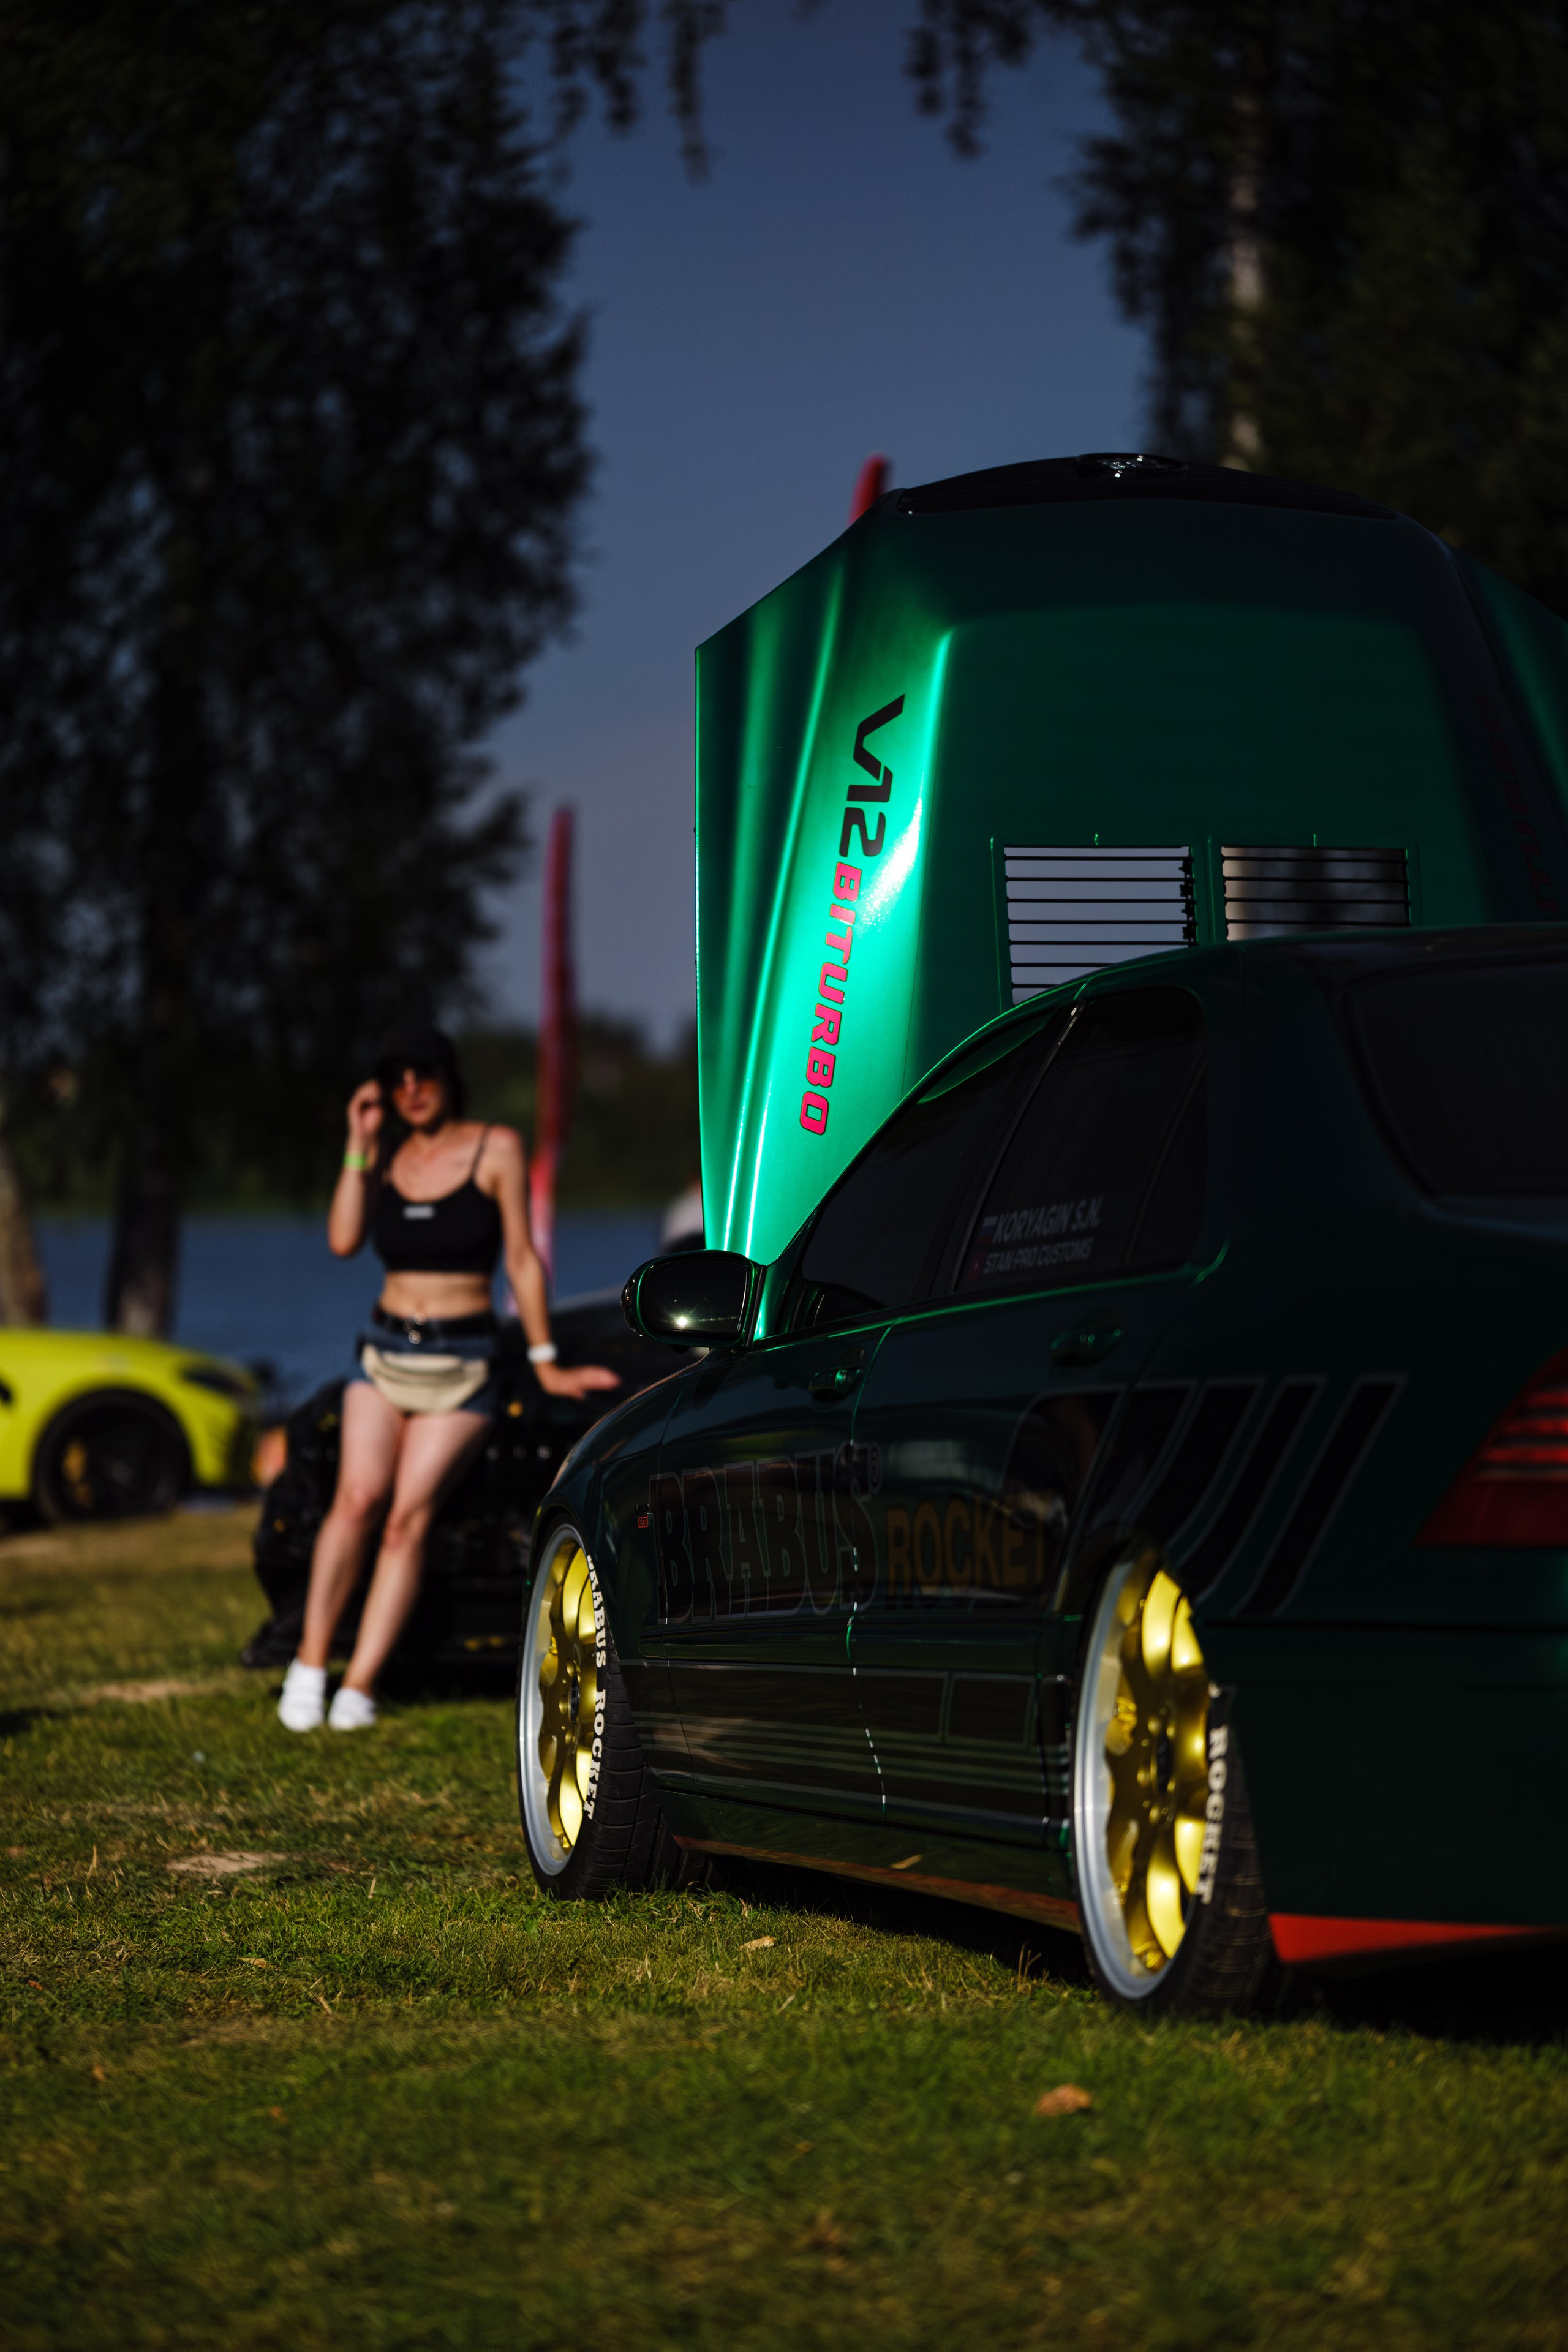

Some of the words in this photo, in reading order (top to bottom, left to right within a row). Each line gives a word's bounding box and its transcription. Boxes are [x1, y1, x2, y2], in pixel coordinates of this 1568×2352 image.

[839, 693, 905, 858] V12
[1476, 694, 1559, 922] ITURBO
[799, 861, 859, 1135] BITURBO
[992, 1200, 1076, 1245] KORYAGIN
[582, 1689, 606, 1820] ROCKET
[1194, 1724, 1229, 1905] ROCKET
